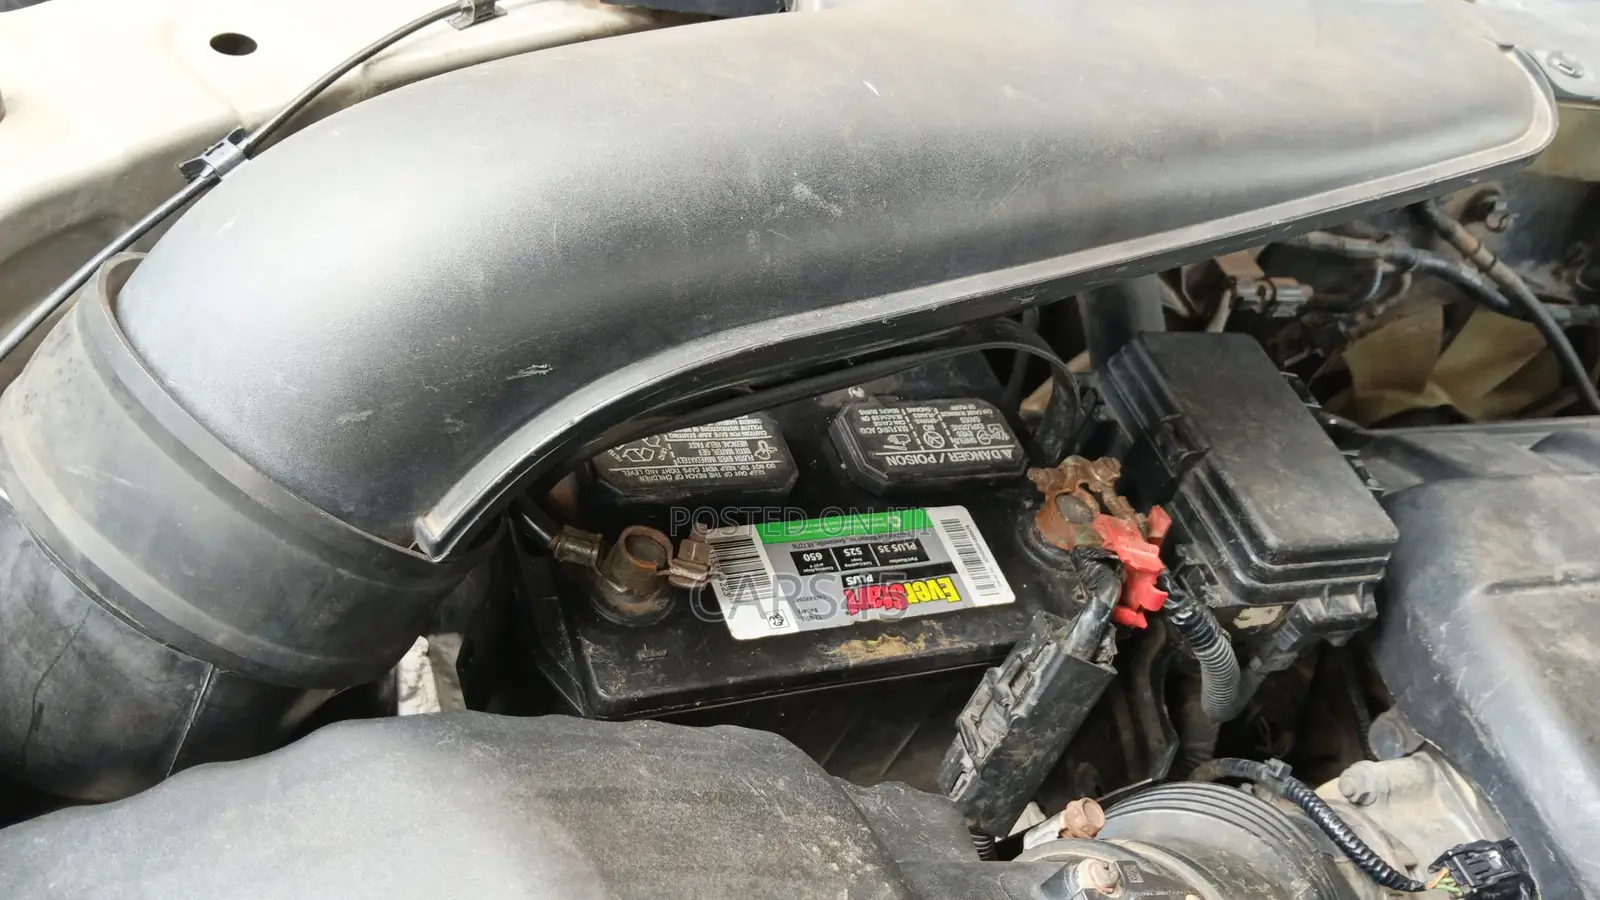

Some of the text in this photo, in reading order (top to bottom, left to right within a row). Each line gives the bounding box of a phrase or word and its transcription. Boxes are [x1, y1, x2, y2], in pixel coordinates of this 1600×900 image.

[885, 450, 1002, 466] DANGER / POISON
[639, 474, 673, 483] CHILDREN
[843, 547, 862, 557] 525
[878, 542, 917, 553] PLUS 35
[803, 552, 823, 562] 650
[845, 574, 874, 586] PLUS
[844, 576, 961, 616] EverStart
